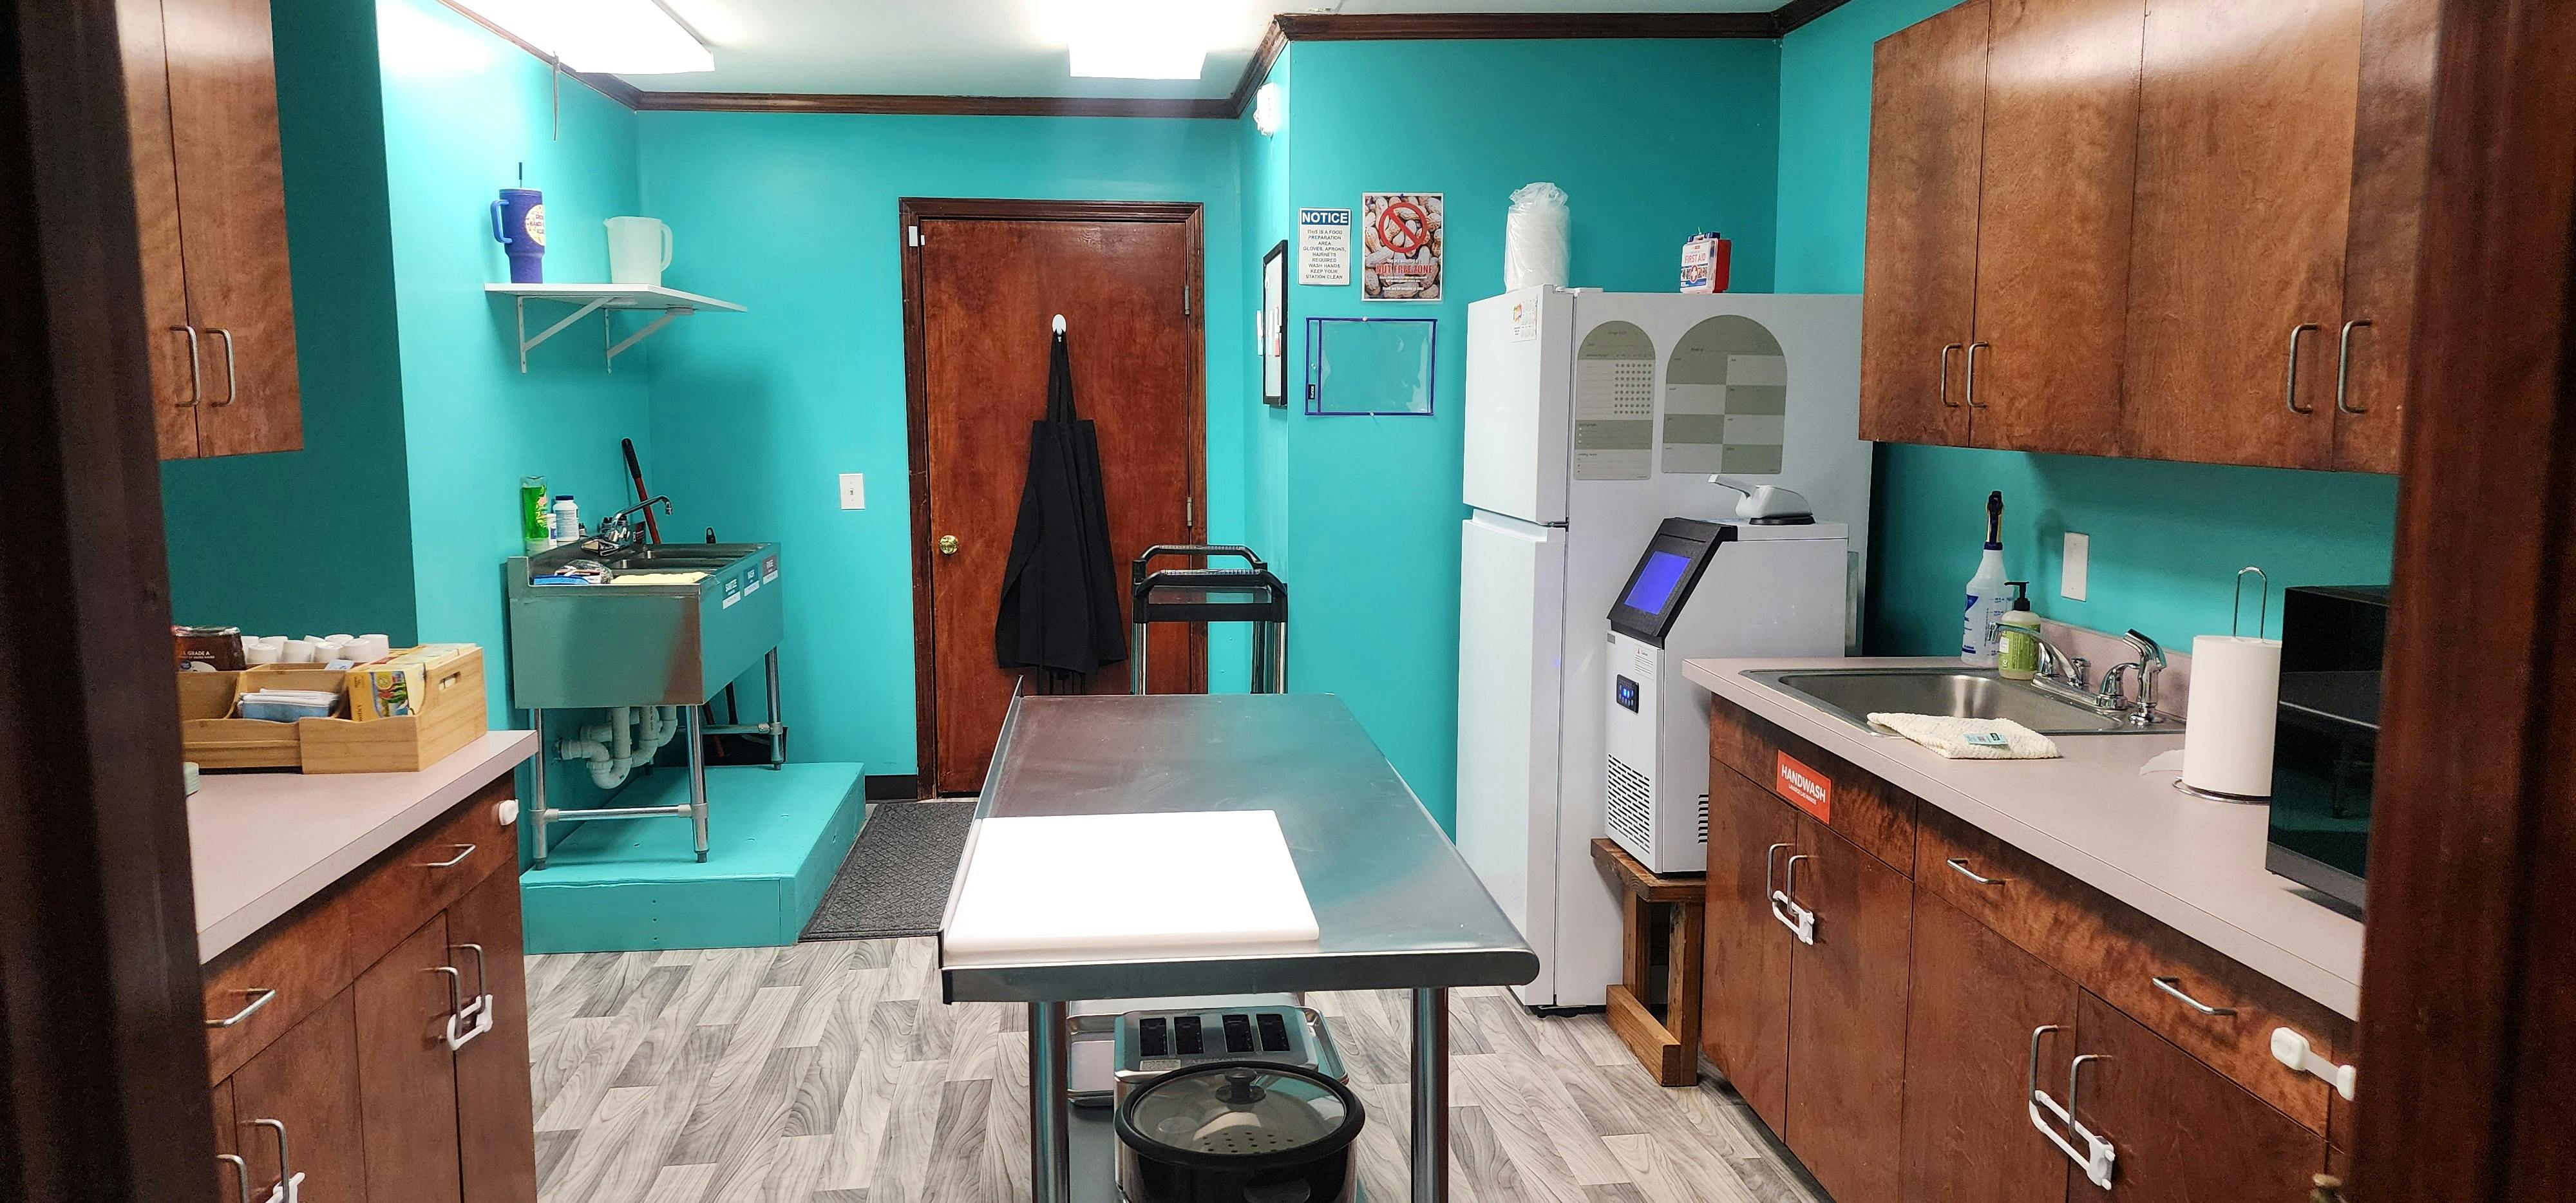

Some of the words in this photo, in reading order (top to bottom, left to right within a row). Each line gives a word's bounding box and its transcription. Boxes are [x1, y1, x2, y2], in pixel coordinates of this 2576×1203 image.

[1302, 212, 1348, 223] NOTICE
[1685, 254, 1698, 264] FIRST
[1698, 252, 1706, 262] AID
[1376, 264, 1392, 274] NUT
[1394, 264, 1412, 274] FREE
[1413, 265, 1434, 274] ZONE
[1781, 764, 1826, 803] HANDWASH
